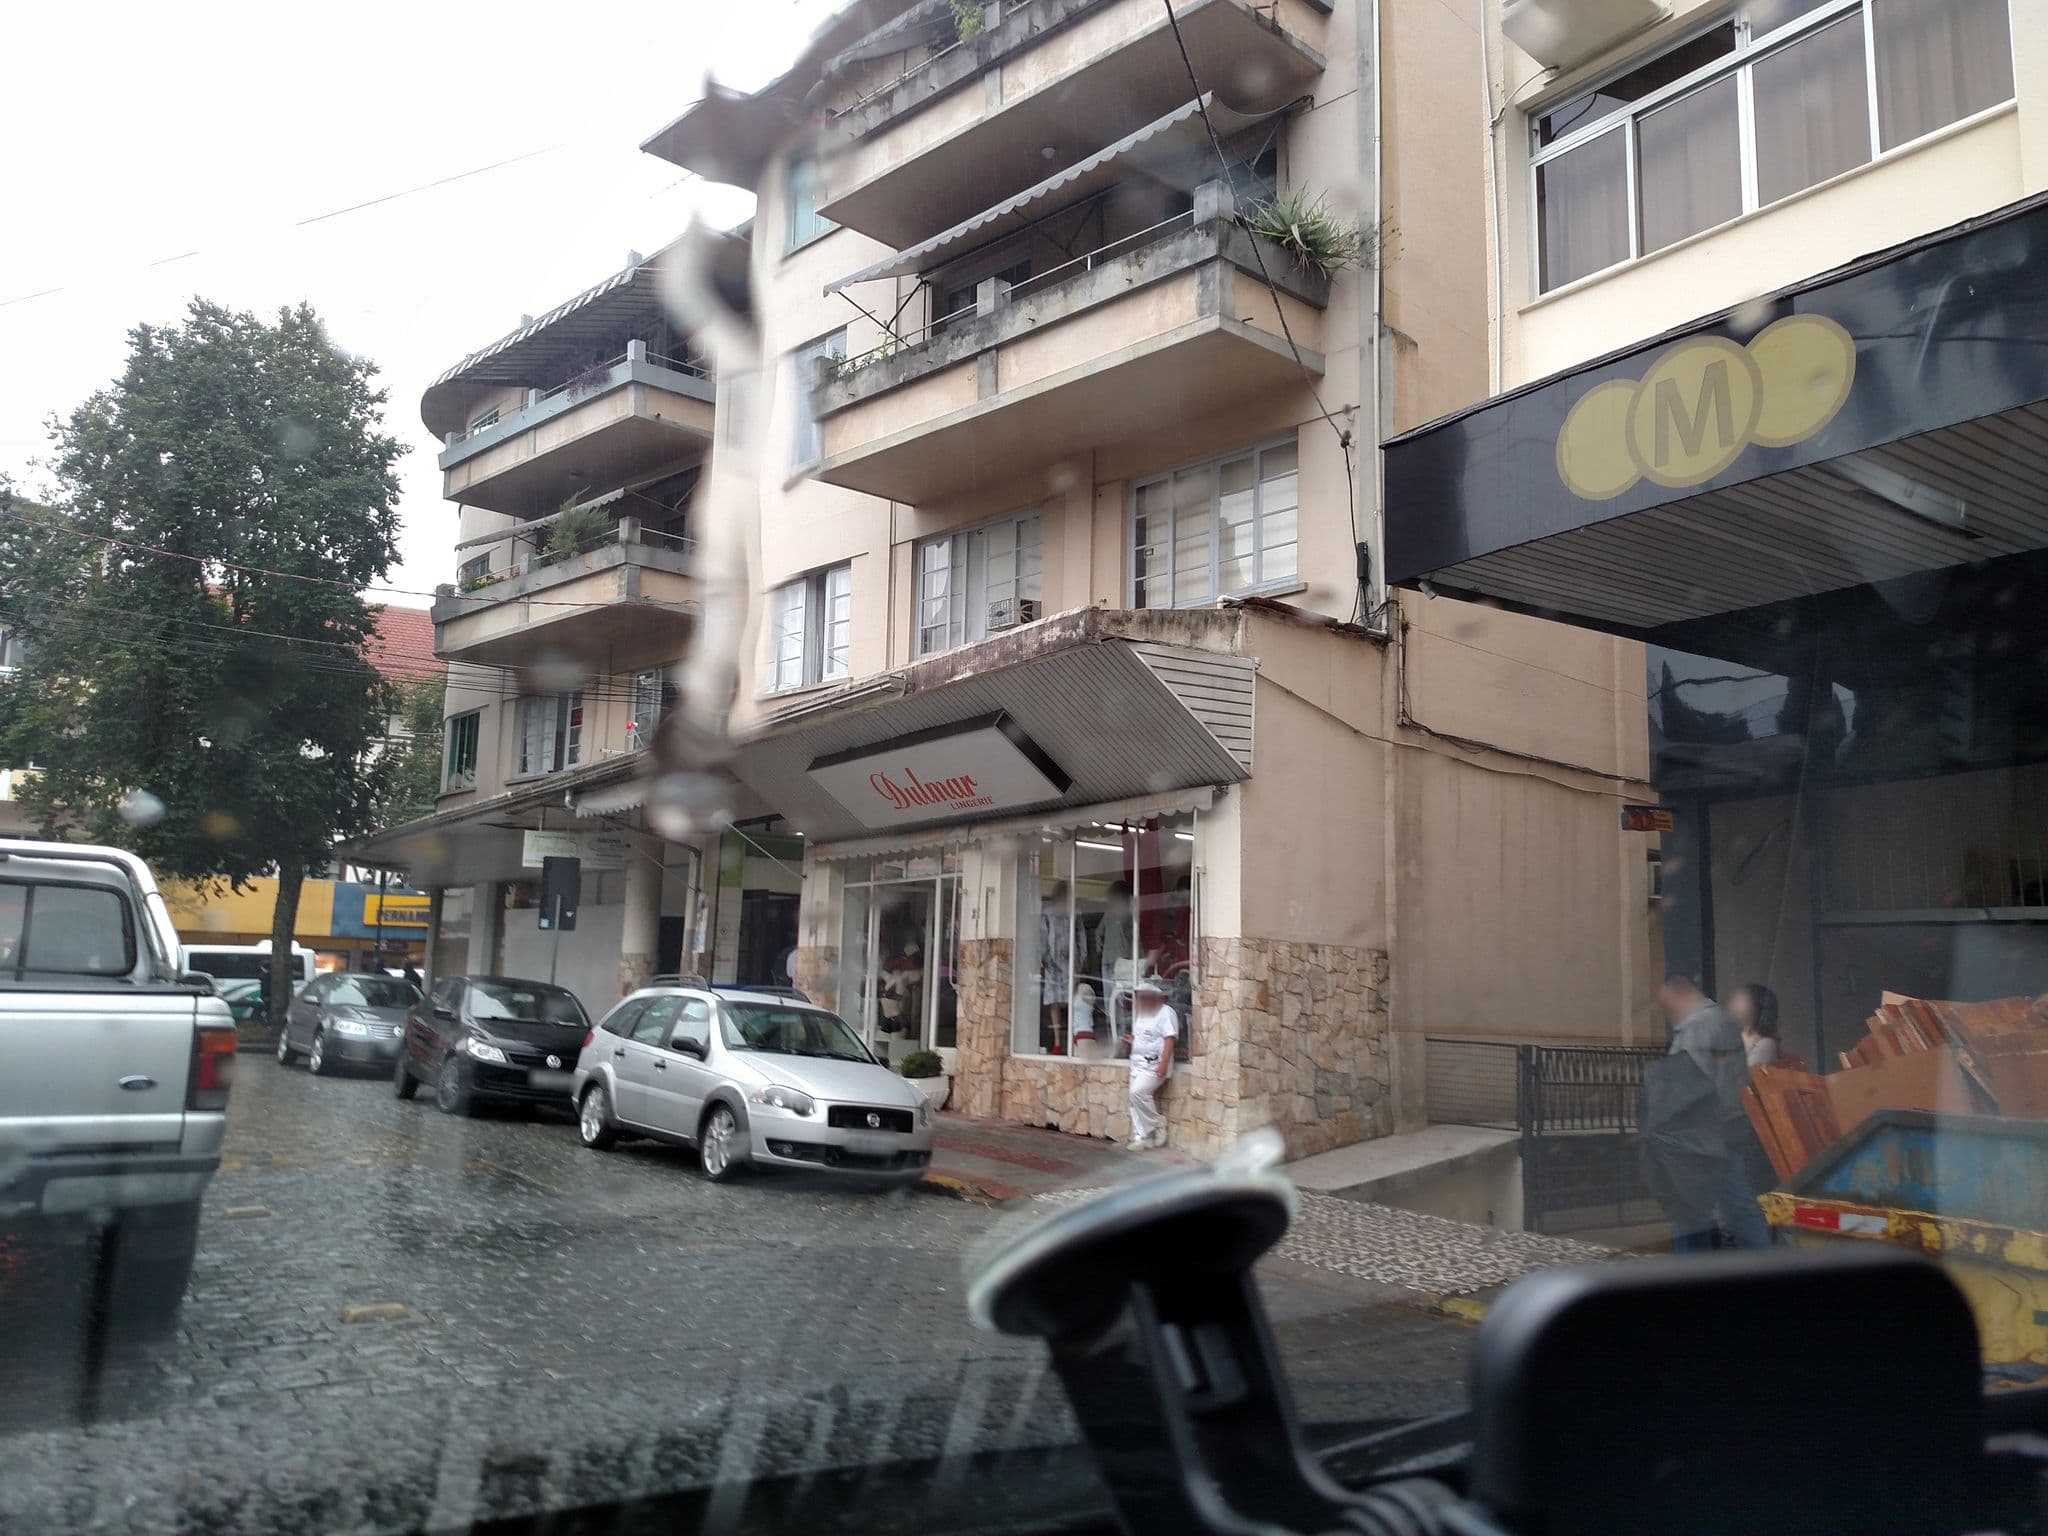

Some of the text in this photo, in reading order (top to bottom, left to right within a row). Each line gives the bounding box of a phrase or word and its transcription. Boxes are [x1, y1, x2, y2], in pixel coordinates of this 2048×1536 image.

[1654, 359, 1735, 467] M
[870, 767, 978, 809] Dulmar
[950, 796, 994, 811] LINGERIE
